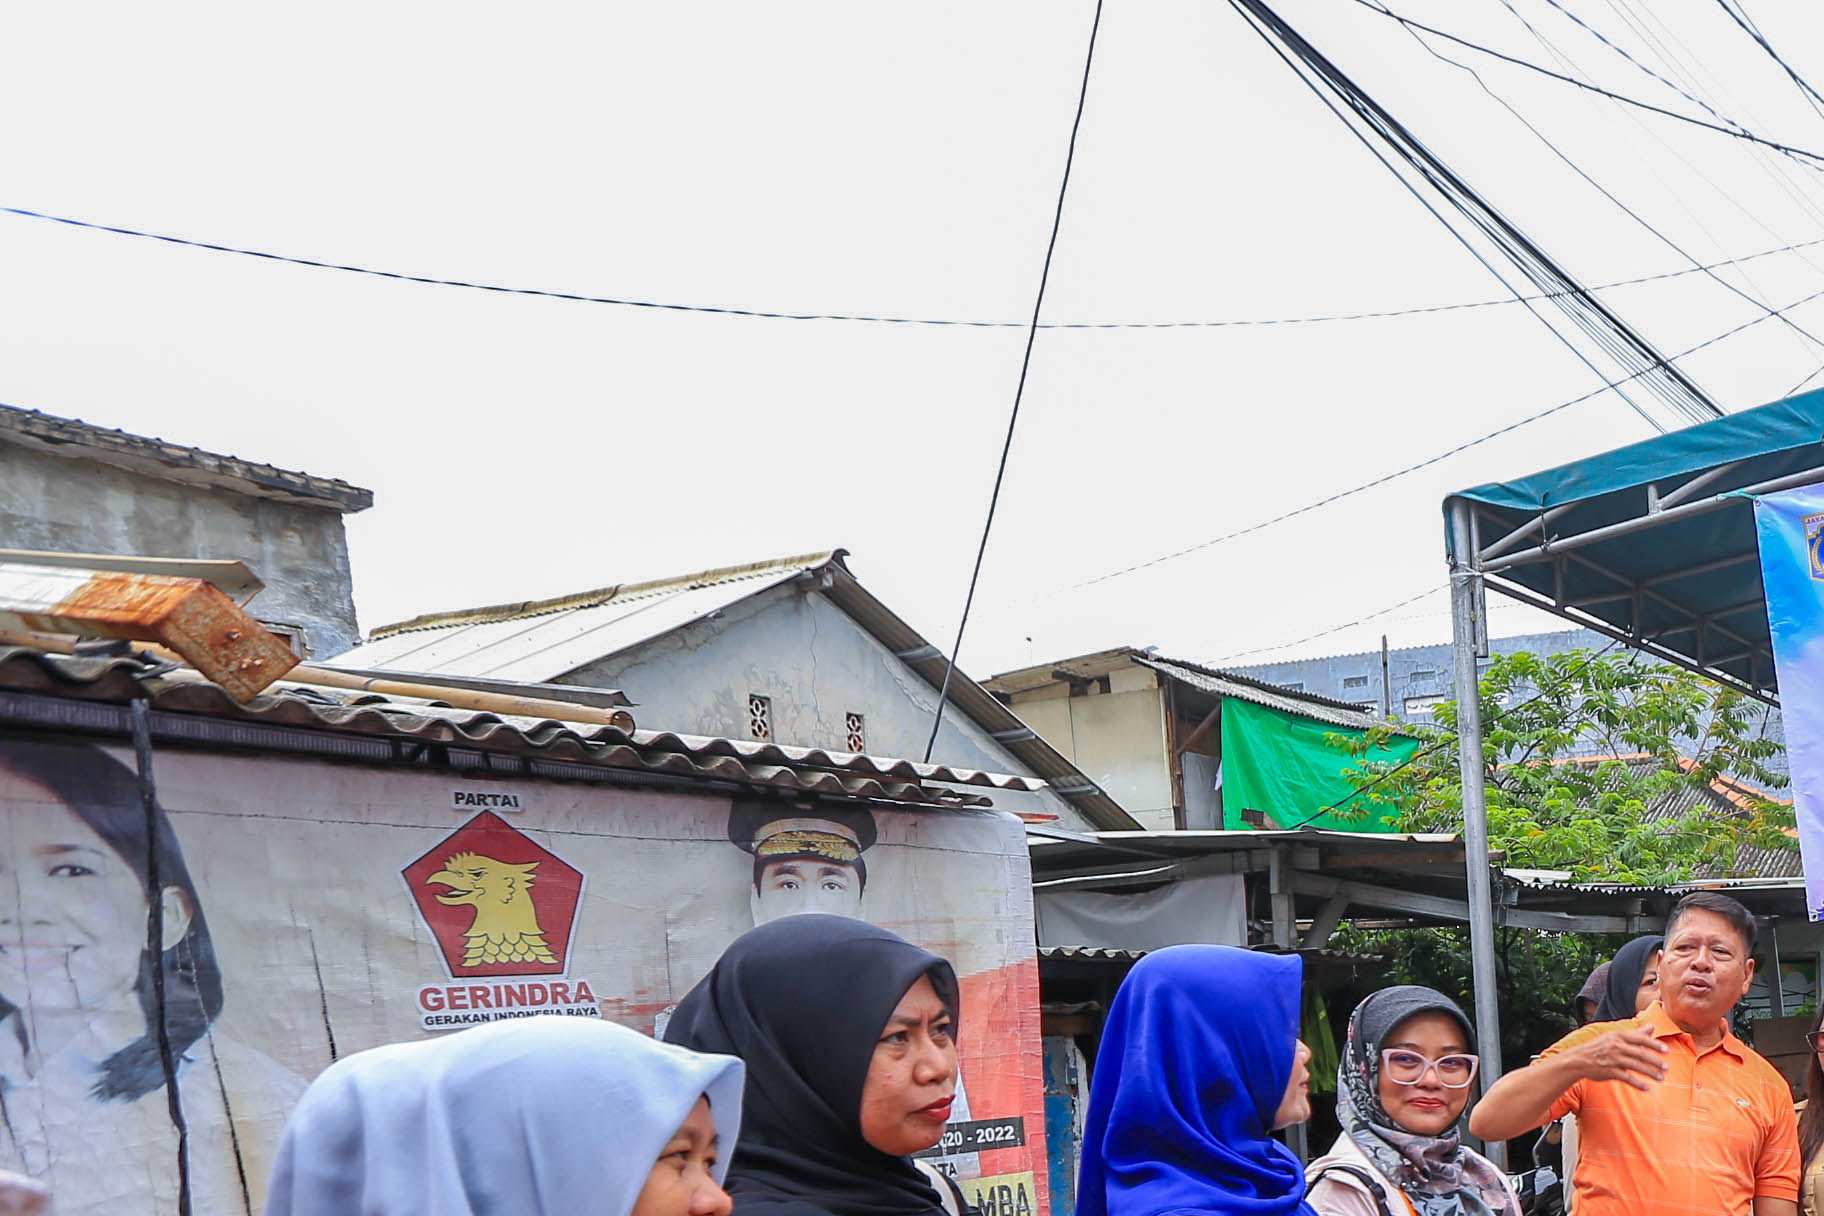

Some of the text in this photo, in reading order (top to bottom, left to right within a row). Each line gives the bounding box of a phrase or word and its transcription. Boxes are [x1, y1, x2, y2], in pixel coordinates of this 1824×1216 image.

[454, 791, 519, 808] PARTAI
[419, 981, 596, 1012] GERINDRA
[424, 1012, 491, 1026] GERAKAN
[975, 1124, 1016, 1144] 2022
